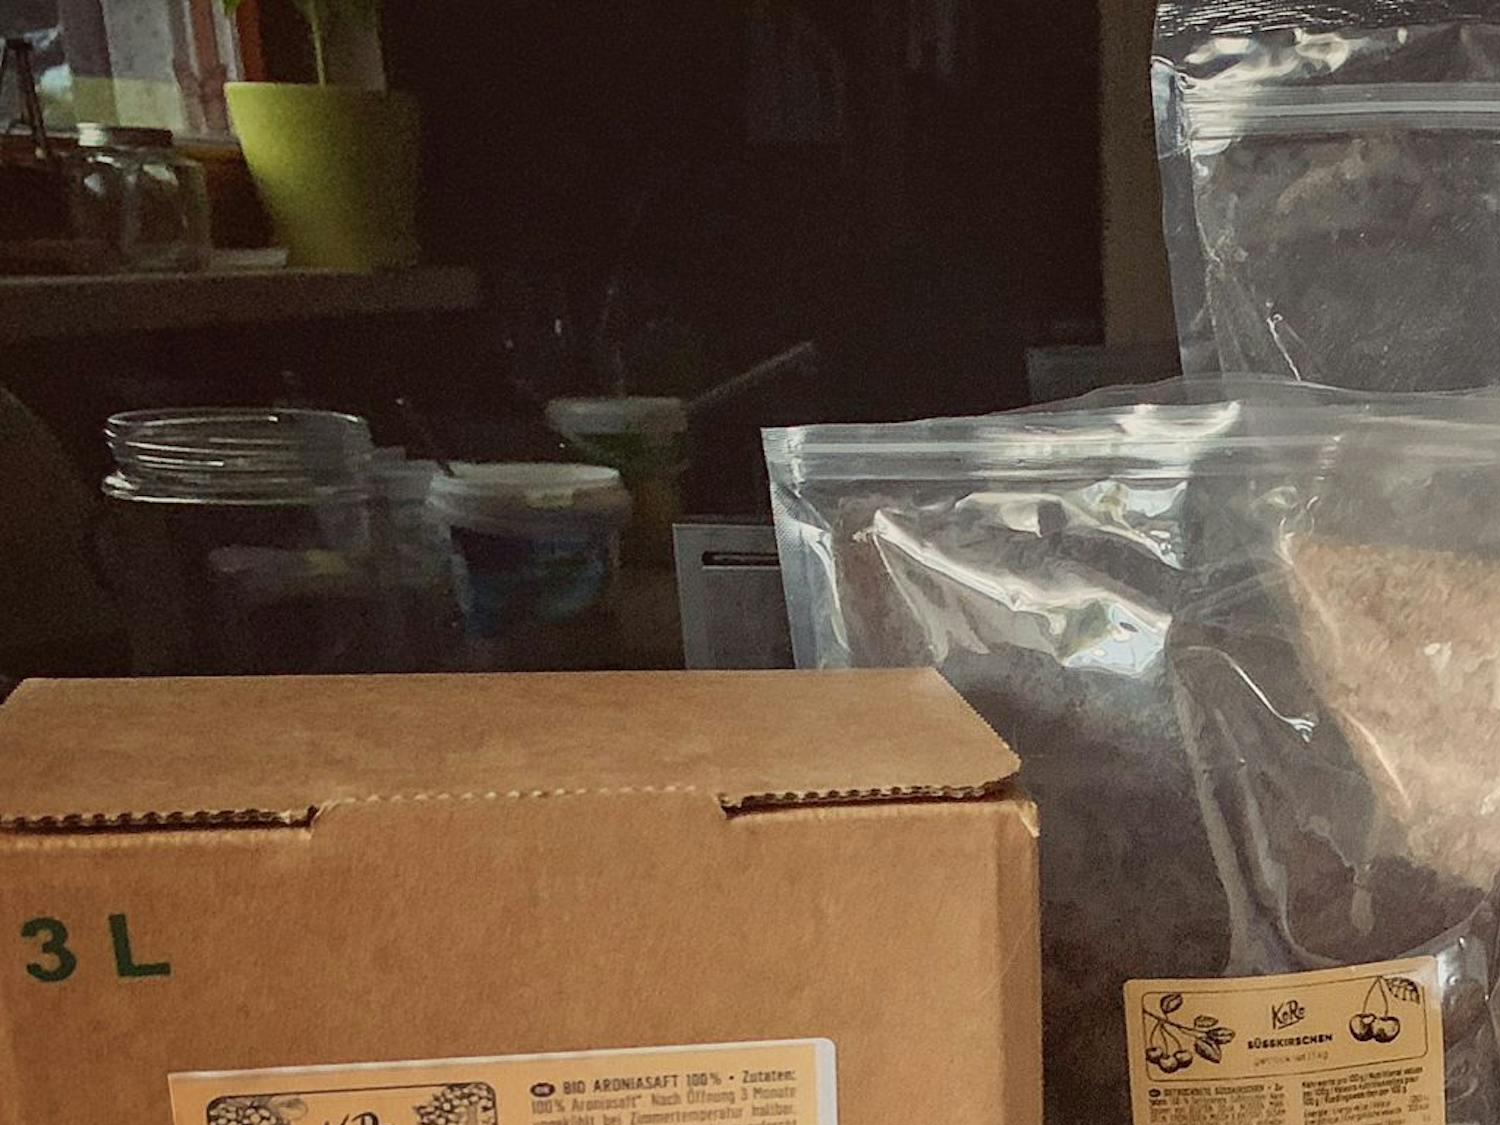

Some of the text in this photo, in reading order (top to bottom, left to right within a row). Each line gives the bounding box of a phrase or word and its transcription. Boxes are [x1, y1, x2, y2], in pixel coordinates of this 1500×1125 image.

[21, 914, 171, 983] 3 L
[1272, 999, 1306, 1030] KoRo
[562, 1081, 585, 1094] BIO
[592, 1075, 678, 1092] ARONIASAFT
